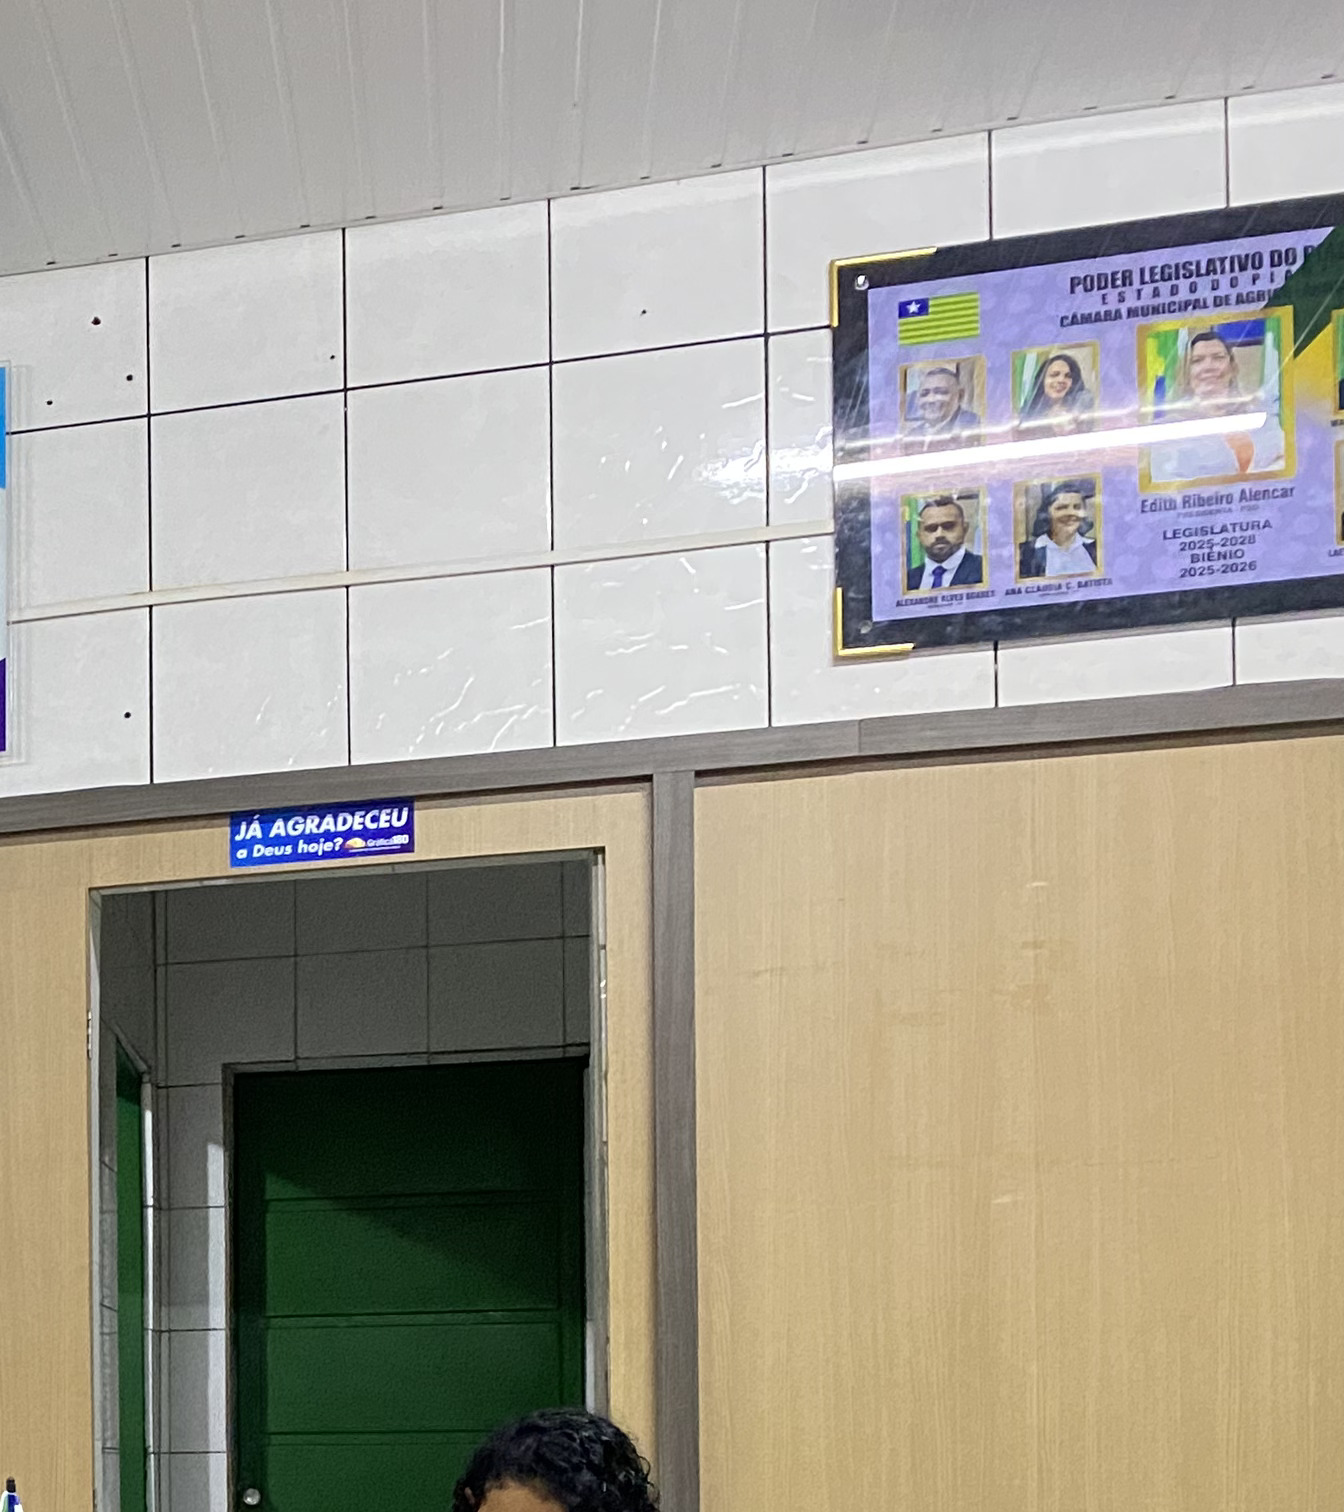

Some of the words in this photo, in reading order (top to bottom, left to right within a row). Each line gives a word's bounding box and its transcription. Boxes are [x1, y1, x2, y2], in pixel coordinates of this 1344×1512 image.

[1070, 269, 1134, 294] PODER
[1139, 251, 1263, 286] LEGISLATIVO
[1270, 247, 1297, 267] DO
[1060, 307, 1123, 328] CÂMARA
[1126, 298, 1209, 319] MUNICIPAL
[1213, 294, 1232, 308] DE
[1141, 498, 1177, 514] Edith
[1182, 491, 1233, 509] Ribeiro
[1238, 486, 1296, 503] Alencar
[1163, 519, 1273, 541] LEGISLATURA
[1179, 534, 1256, 551] 2025-2028
[1179, 561, 1257, 578] 2025-2026
[234, 815, 263, 841] JÁ
[269, 807, 409, 838] AGRADECEU
[236, 848, 248, 859] a
[252, 844, 292, 858] Deus
[297, 838, 344, 856] hoje?
